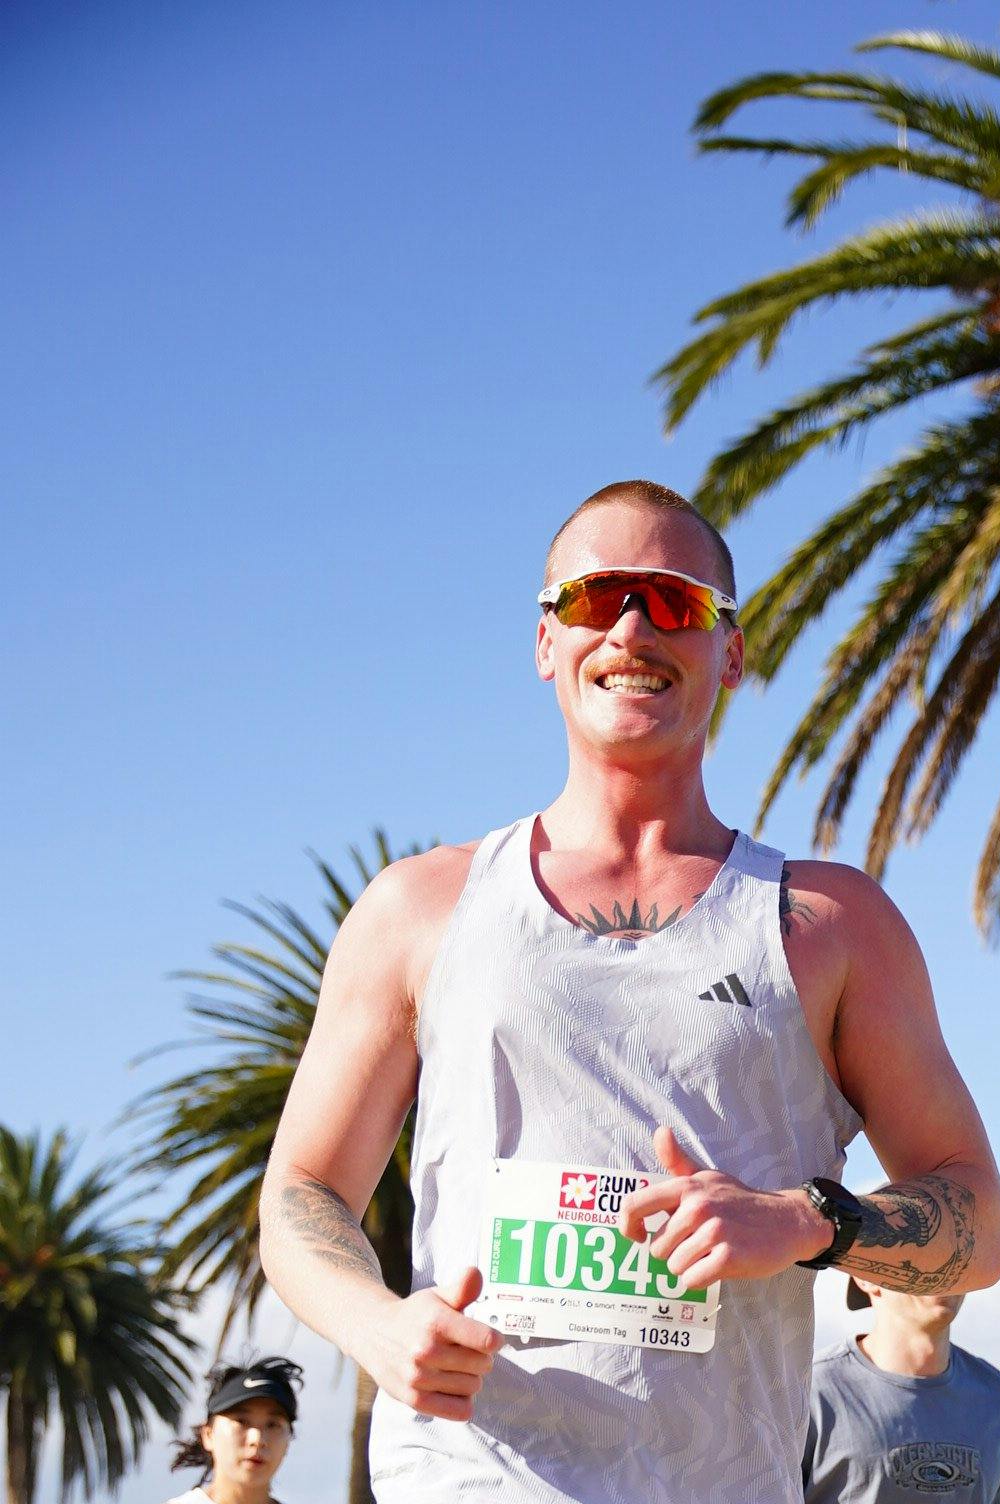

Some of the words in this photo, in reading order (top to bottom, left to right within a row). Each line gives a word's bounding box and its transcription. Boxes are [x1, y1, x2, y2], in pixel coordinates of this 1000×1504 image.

[597, 1193, 622, 1213] CU
[557, 1210, 618, 1226] NEUROBLAS
[568, 1322, 611, 1335] Cloakroom
[613, 1327, 627, 1338] Tag
[639, 1327, 690, 1347] 10343
